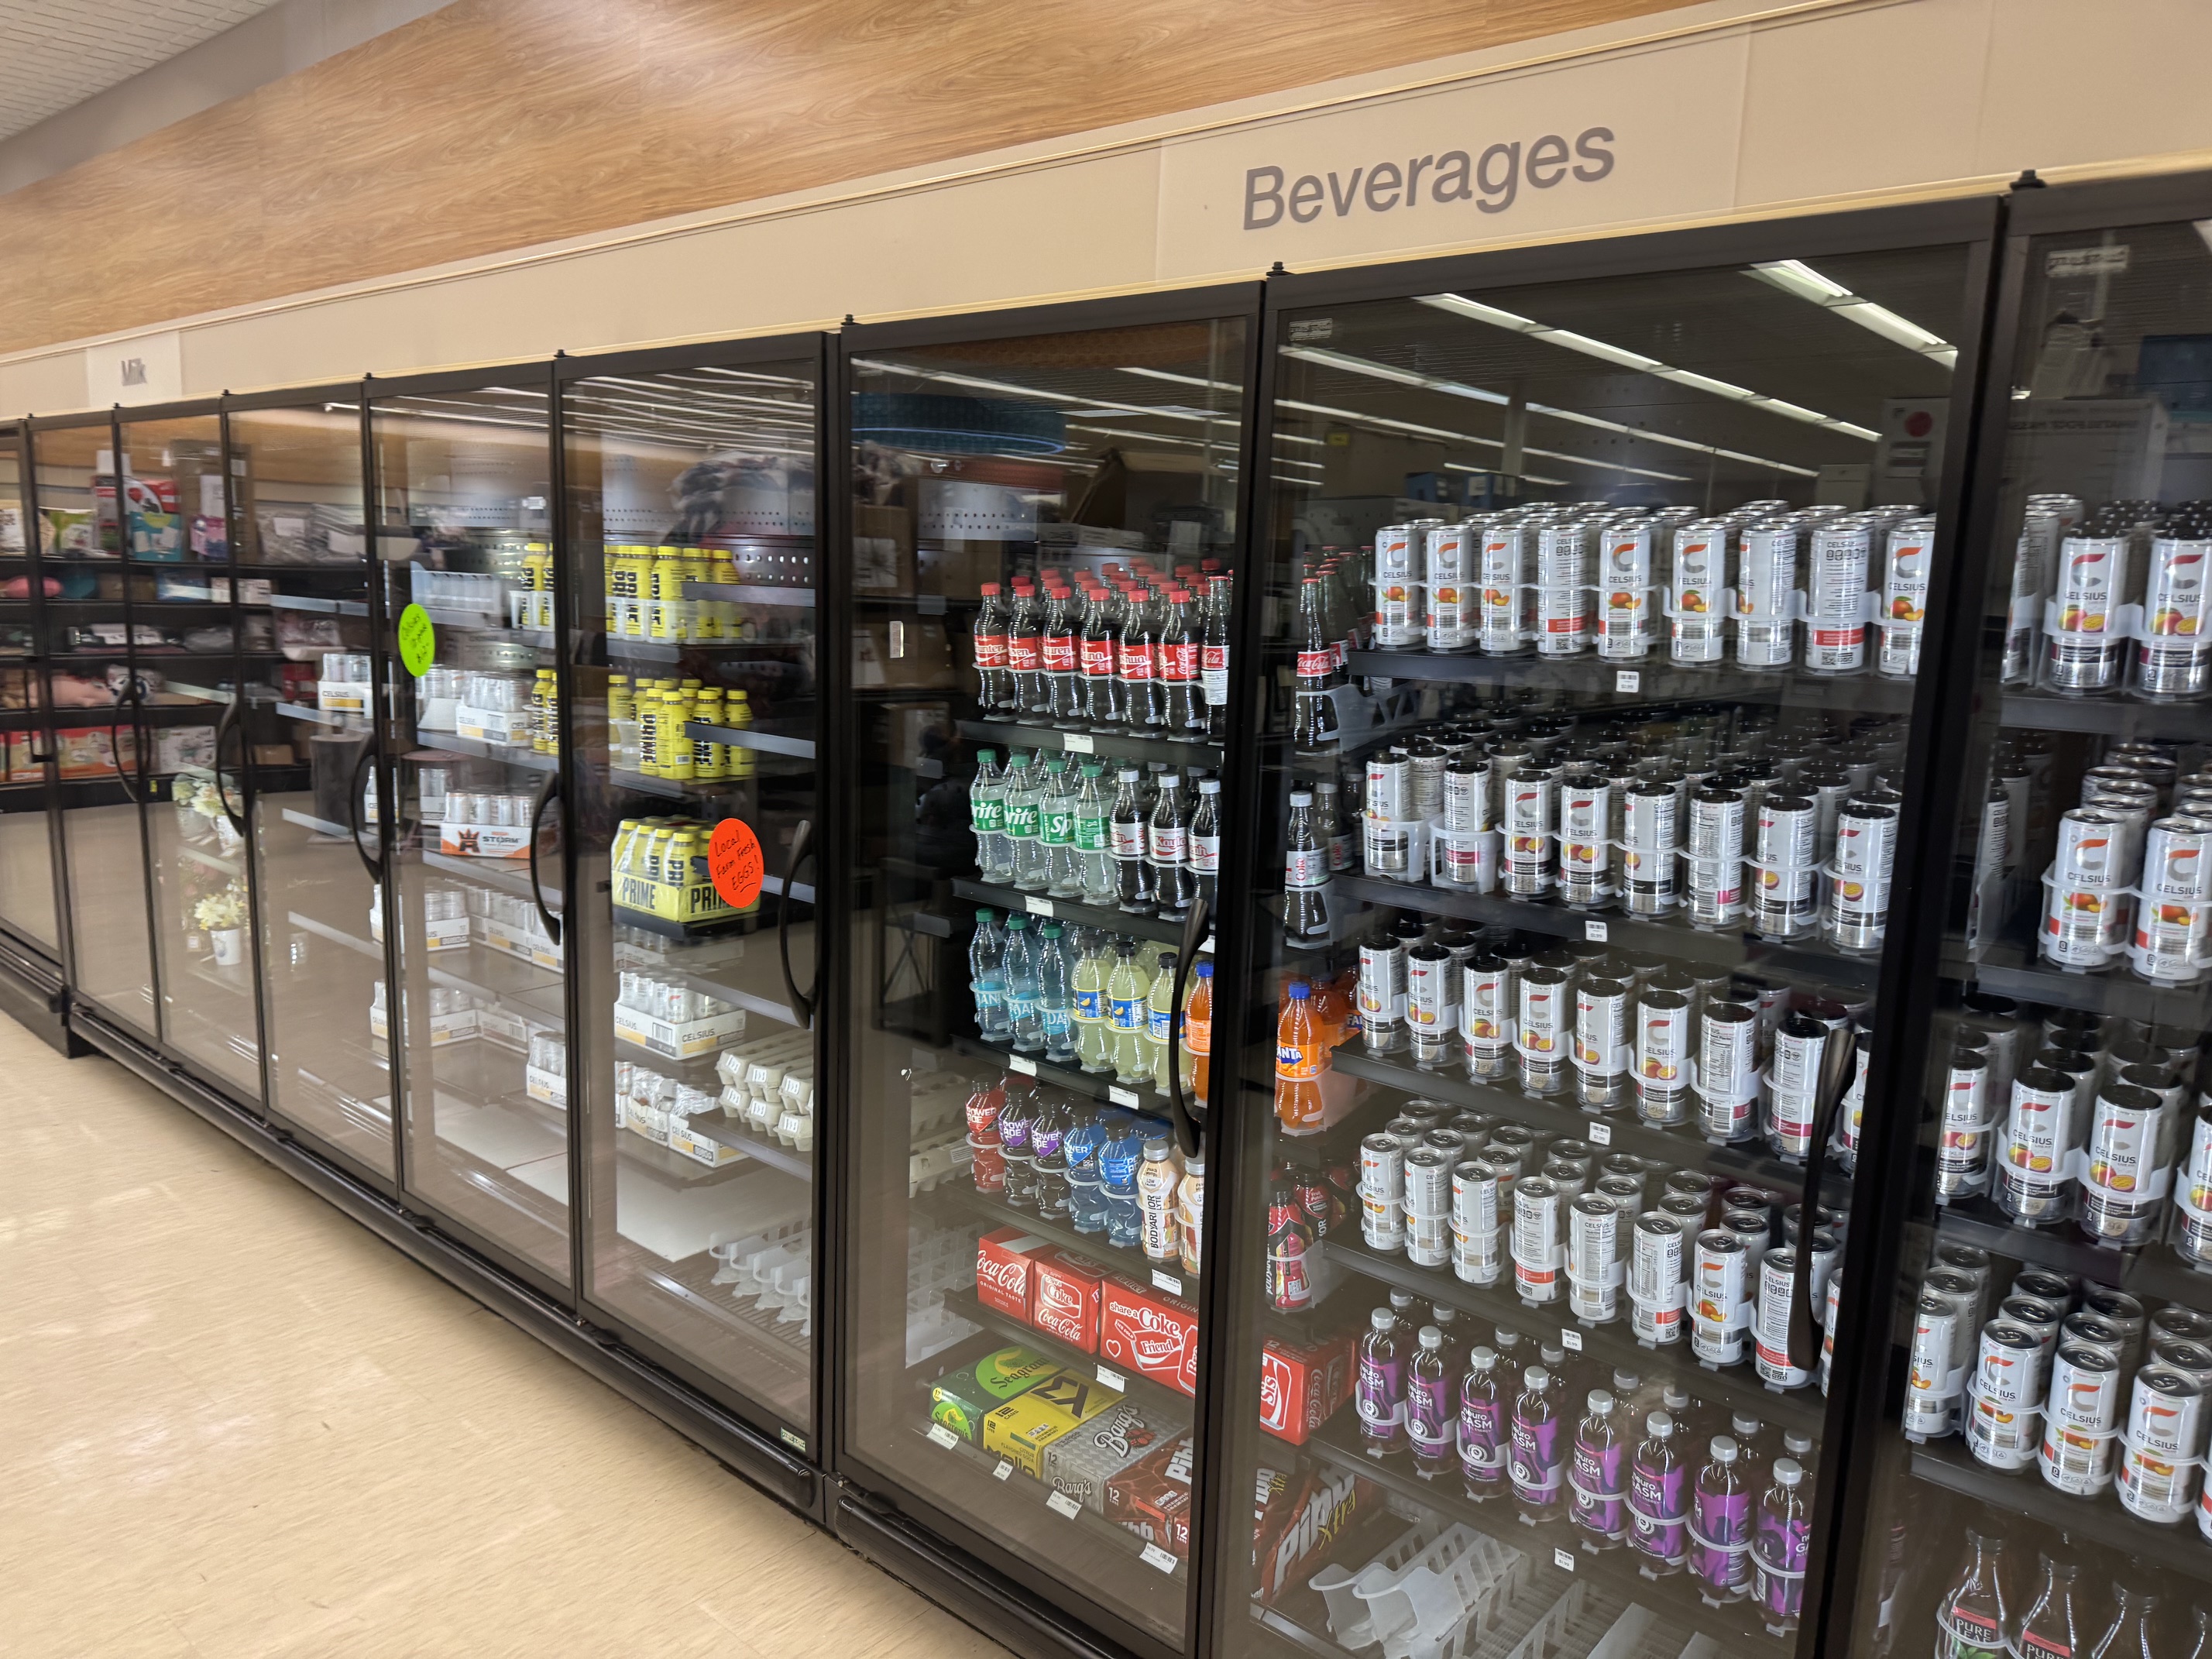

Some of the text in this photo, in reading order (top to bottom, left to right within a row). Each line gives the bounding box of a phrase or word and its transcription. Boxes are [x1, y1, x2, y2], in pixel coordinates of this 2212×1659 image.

[1242, 125, 1616, 232] Beverages
[2064, 591, 2107, 601] CELSIUS
[2158, 592, 2205, 603] CELSIUS
[970, 802, 1003, 819] rite
[714, 830, 740, 857] Local
[2066, 871, 2111, 884] CELSIUS
[623, 876, 657, 910] PRIME
[2156, 883, 2203, 895] CELSIUS
[1472, 1008, 1503, 1016] CELSIUS
[1523, 1018, 1554, 1029] CELSIUS
[682, 1028, 716, 1043] CELSIUS
[1643, 1046, 1676, 1056] CELSIUS
[2013, 1128, 2052, 1146] CELSIUS
[2095, 1146, 2136, 1164] CELSIUS
[979, 1280, 1022, 1304] ORIGINAL TASTE
[1046, 1283, 1073, 1305] Coke
[1695, 1283, 1728, 1300] CELSIUS
[1109, 1302, 1132, 1316] share
[1038, 1308, 1083, 1341] Coca-Cola
[1142, 1340, 1173, 1353] Friend
[1980, 1378, 2016, 1399] CELSIUS
[994, 1407, 1015, 1417] 12
[1461, 1411, 1492, 1430] GASM
[1462, 1407, 1488, 1420] neuro
[2060, 1407, 2101, 1424] CELSIUS
[1093, 1405, 1141, 1458] Barq's
[2136, 1431, 2179, 1450] CELSIUS
[1047, 1451, 1058, 1465] 12
[1052, 1476, 1092, 1503] Barq's
[1108, 1486, 1120, 1502] 12
[1176, 1523, 1189, 1540] 12
[1956, 1618, 1991, 1637] PURE
